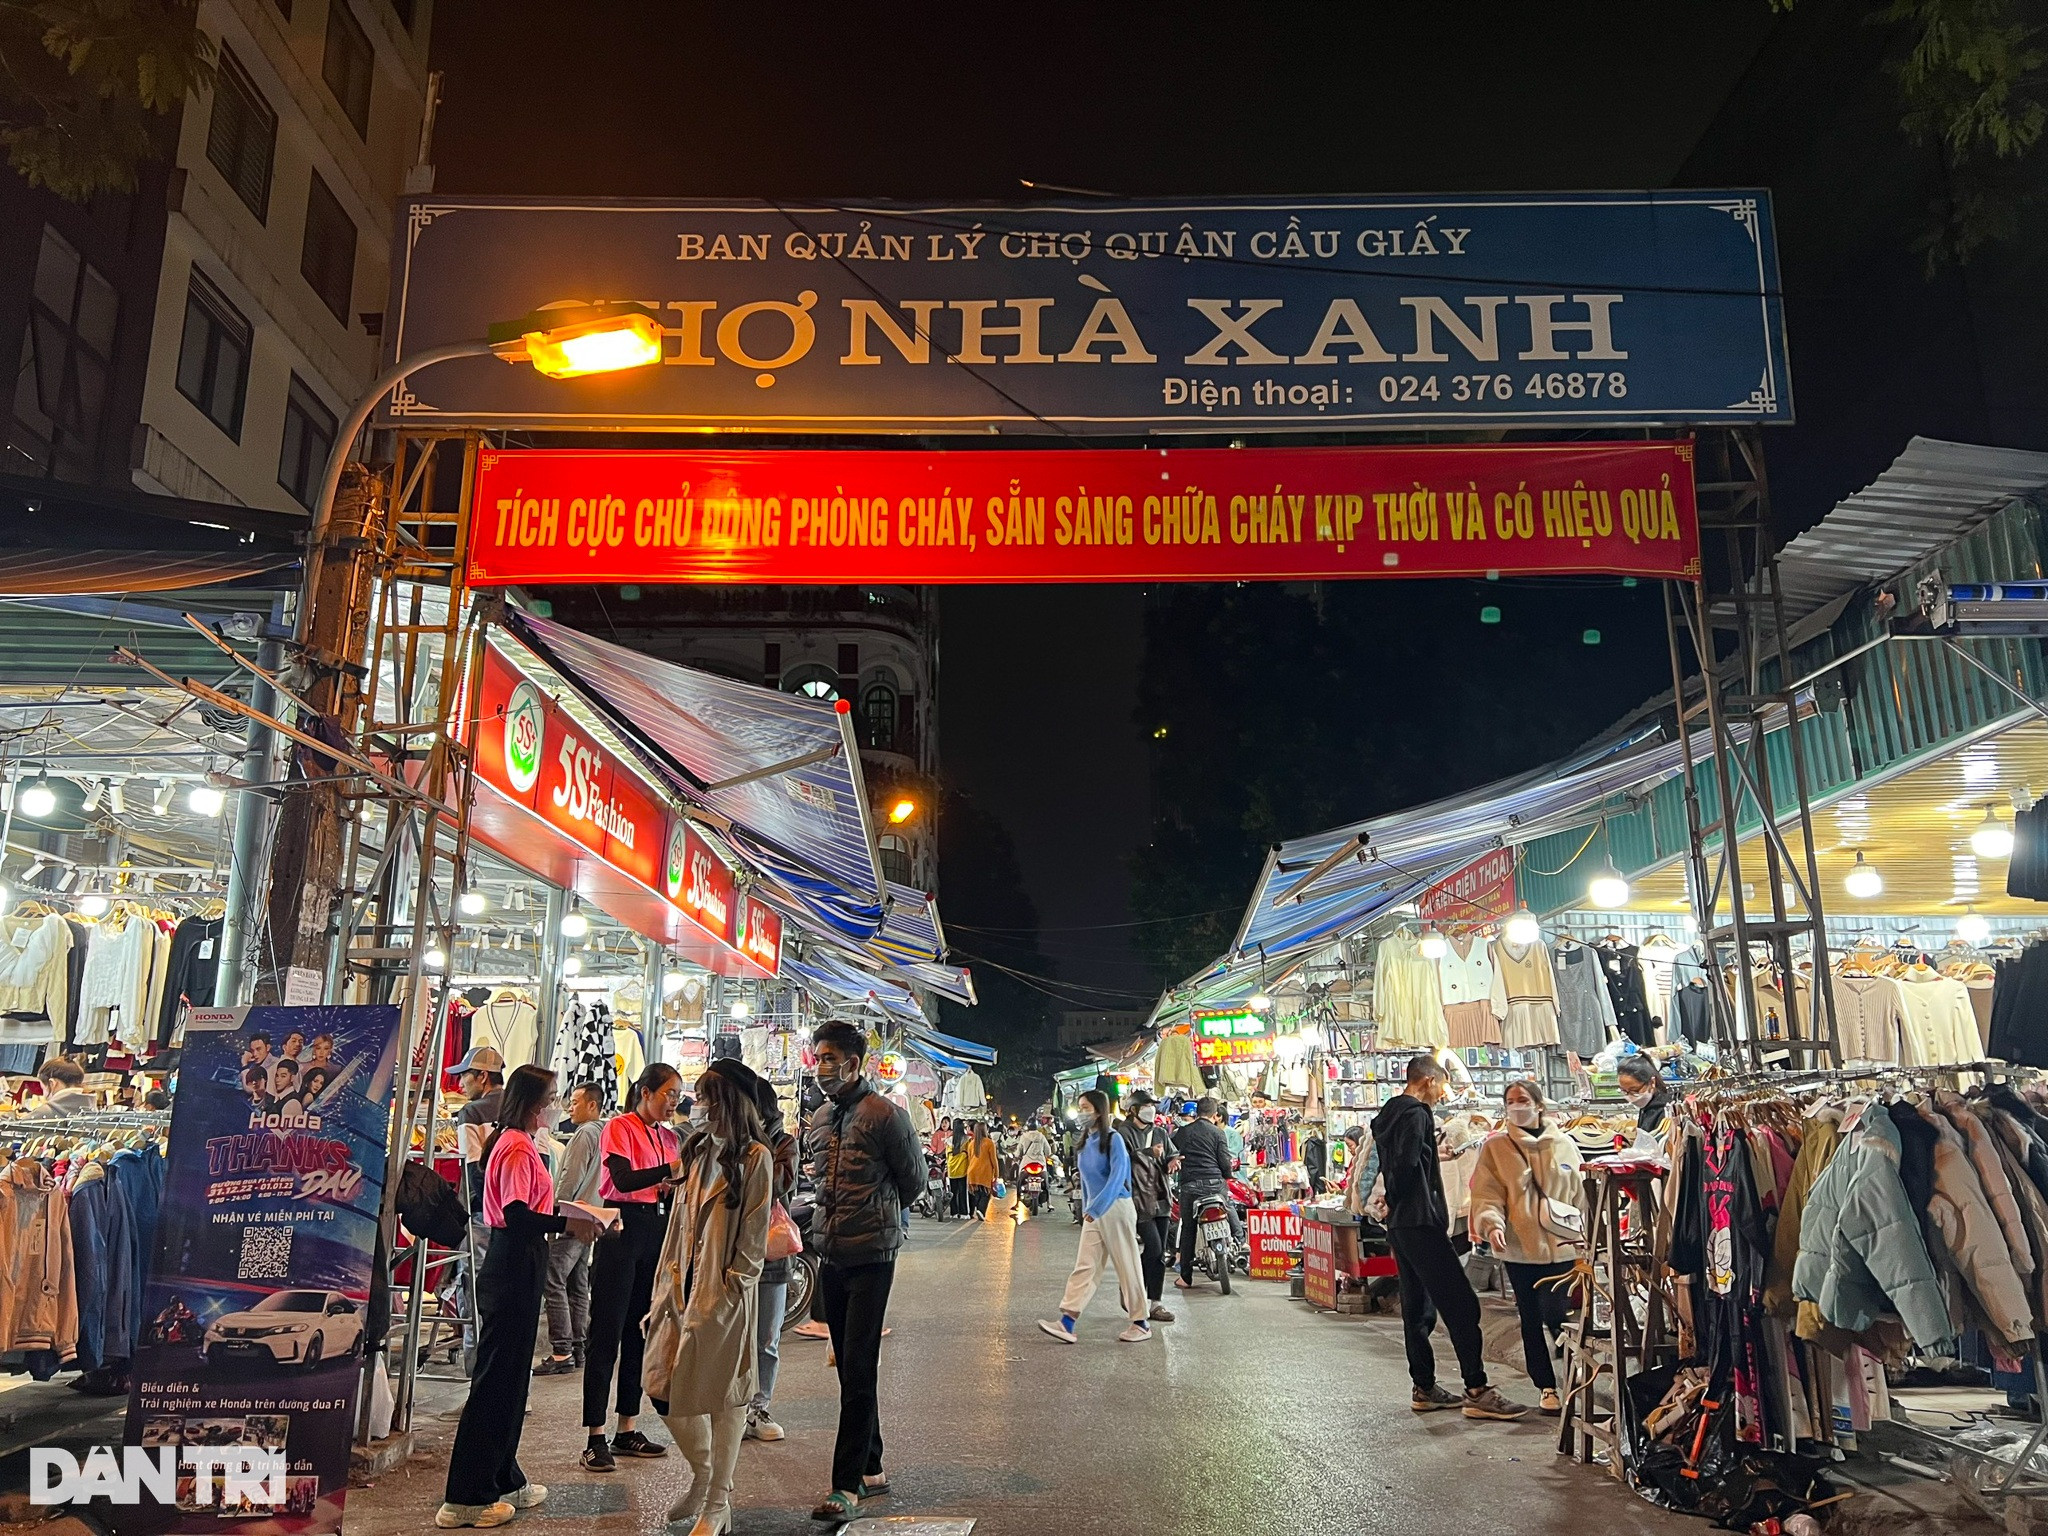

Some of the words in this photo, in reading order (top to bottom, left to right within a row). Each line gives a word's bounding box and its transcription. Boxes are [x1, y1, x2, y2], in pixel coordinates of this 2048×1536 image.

[677, 234, 771, 260] BAN
[784, 221, 914, 262] QUẢN
[928, 224, 986, 259] LÝ
[1000, 230, 1092, 266] CHỢ
[1106, 224, 1237, 263] QUẬN
[1250, 216, 1339, 258] CẦU
[1357, 216, 1471, 256] GIẤY
[535, 289, 818, 388] HỢ
[840, 274, 1157, 365] NHÀ
[1185, 294, 1629, 365] XANH
[1163, 376, 1241, 413] Điện
[1253, 377, 1353, 411] thoại:
[1379, 375, 1440, 403] 024
[1452, 374, 1514, 402] 376
[1525, 372, 1628, 400] 46878
[495, 488, 560, 547] TÍCH
[567, 493, 625, 557] CỰC
[634, 480, 694, 547] CHỦ
[789, 485, 889, 547] PHÒNG
[898, 486, 977, 553] CHÁY,
[986, 478, 1045, 546] SẴN
[1055, 485, 1133, 546] SÀNG
[1143, 486, 1221, 545] CHỮA
[1230, 483, 1306, 544] CHÁY
[1315, 494, 1363, 553] KỊP
[1373, 481, 1440, 541] THỜI
[1446, 480, 1487, 541] VÀ
[1494, 480, 1534, 541] CÓ
[1542, 479, 1613, 548] HIỆU
[1621, 472, 1681, 545] QUẢ
[586, 784, 635, 850] Fashion
[249, 1110, 322, 1130] Honda
[206, 1134, 351, 1175] THANKS
[208, 1185, 252, 1197] 31.12.22
[260, 1182, 294, 1190] 01.01.23
[291, 1169, 361, 1200] DAY
[213, 1211, 249, 1225] NHẬN
[251, 1211, 262, 1221] VÉ
[264, 1208, 292, 1221] MIỄN
[296, 1209, 314, 1221] PHÍ
[318, 1210, 335, 1222] TẠI
[1250, 1212, 1281, 1235] DÁN
[1261, 1236, 1292, 1252] CƯỜNG
[141, 1382, 165, 1394] Biểu
[167, 1382, 190, 1394] diễn
[140, 1398, 161, 1409] Trải
[163, 1397, 202, 1411] nghiệm
[204, 1401, 218, 1410] xe
[220, 1399, 250, 1410] Honda
[254, 1399, 276, 1410] trên
[278, 1399, 310, 1413] đường
[335, 1400, 346, 1410] F1
[294, 1459, 313, 1471] dẫn
